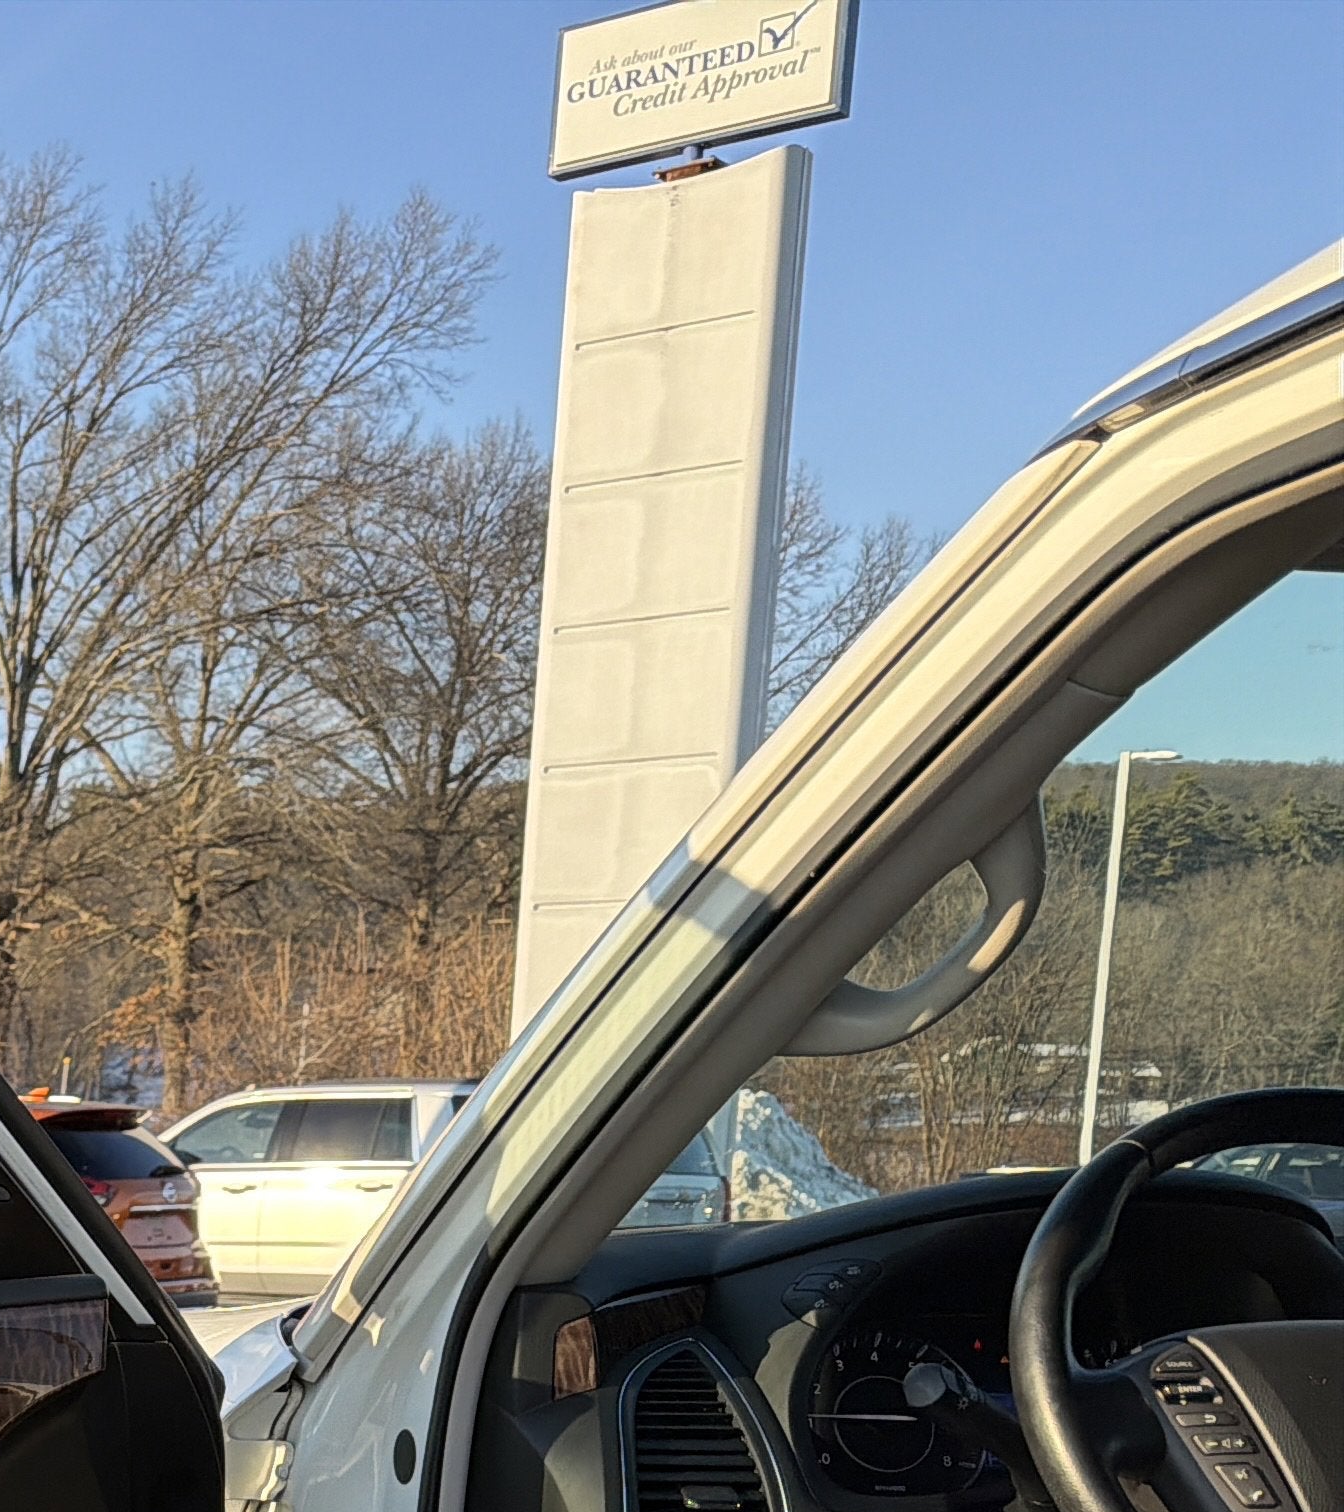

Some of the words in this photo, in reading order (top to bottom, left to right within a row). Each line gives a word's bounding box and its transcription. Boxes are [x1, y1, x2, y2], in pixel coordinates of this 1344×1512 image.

[590, 58, 617, 75] Ask
[621, 43, 663, 67] about
[669, 38, 697, 56] our
[567, 41, 755, 104] GUARANTEED
[613, 82, 686, 117] Credit
[692, 50, 808, 103] Approval
[836, 1360, 844, 1371] 3
[870, 1351, 879, 1362] 4
[943, 1455, 952, 1467] 8
